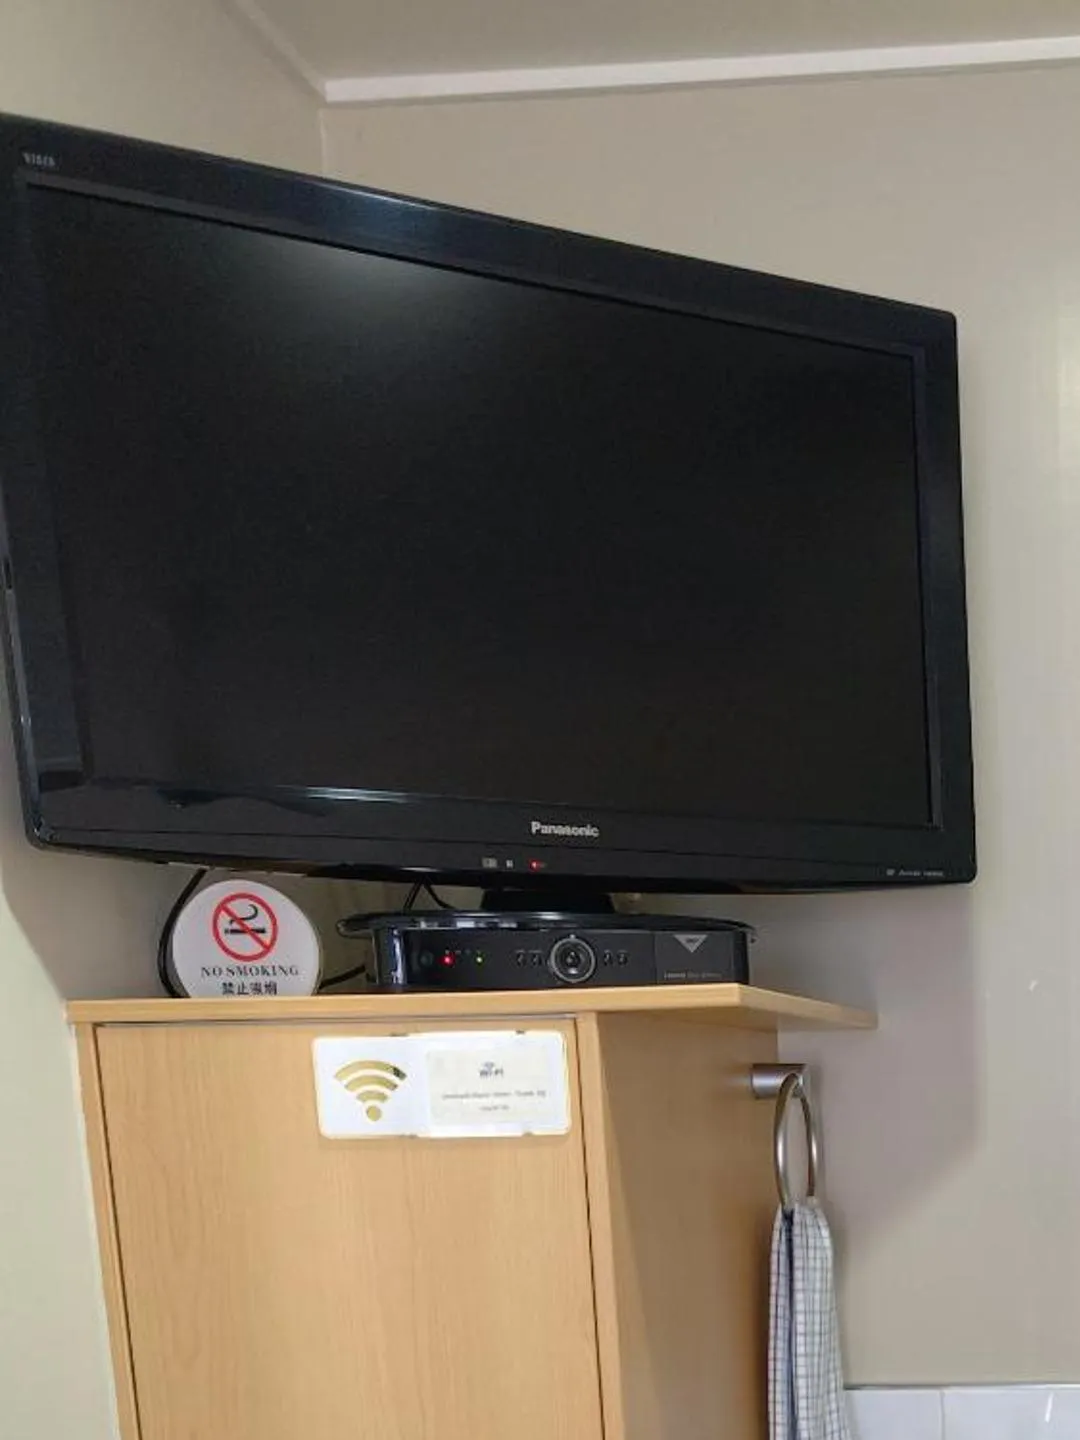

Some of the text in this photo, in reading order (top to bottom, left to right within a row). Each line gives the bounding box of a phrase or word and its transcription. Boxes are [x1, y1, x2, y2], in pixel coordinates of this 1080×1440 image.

[530, 820, 600, 838] Panasonic
[201, 964, 299, 978] NO SMOKING
